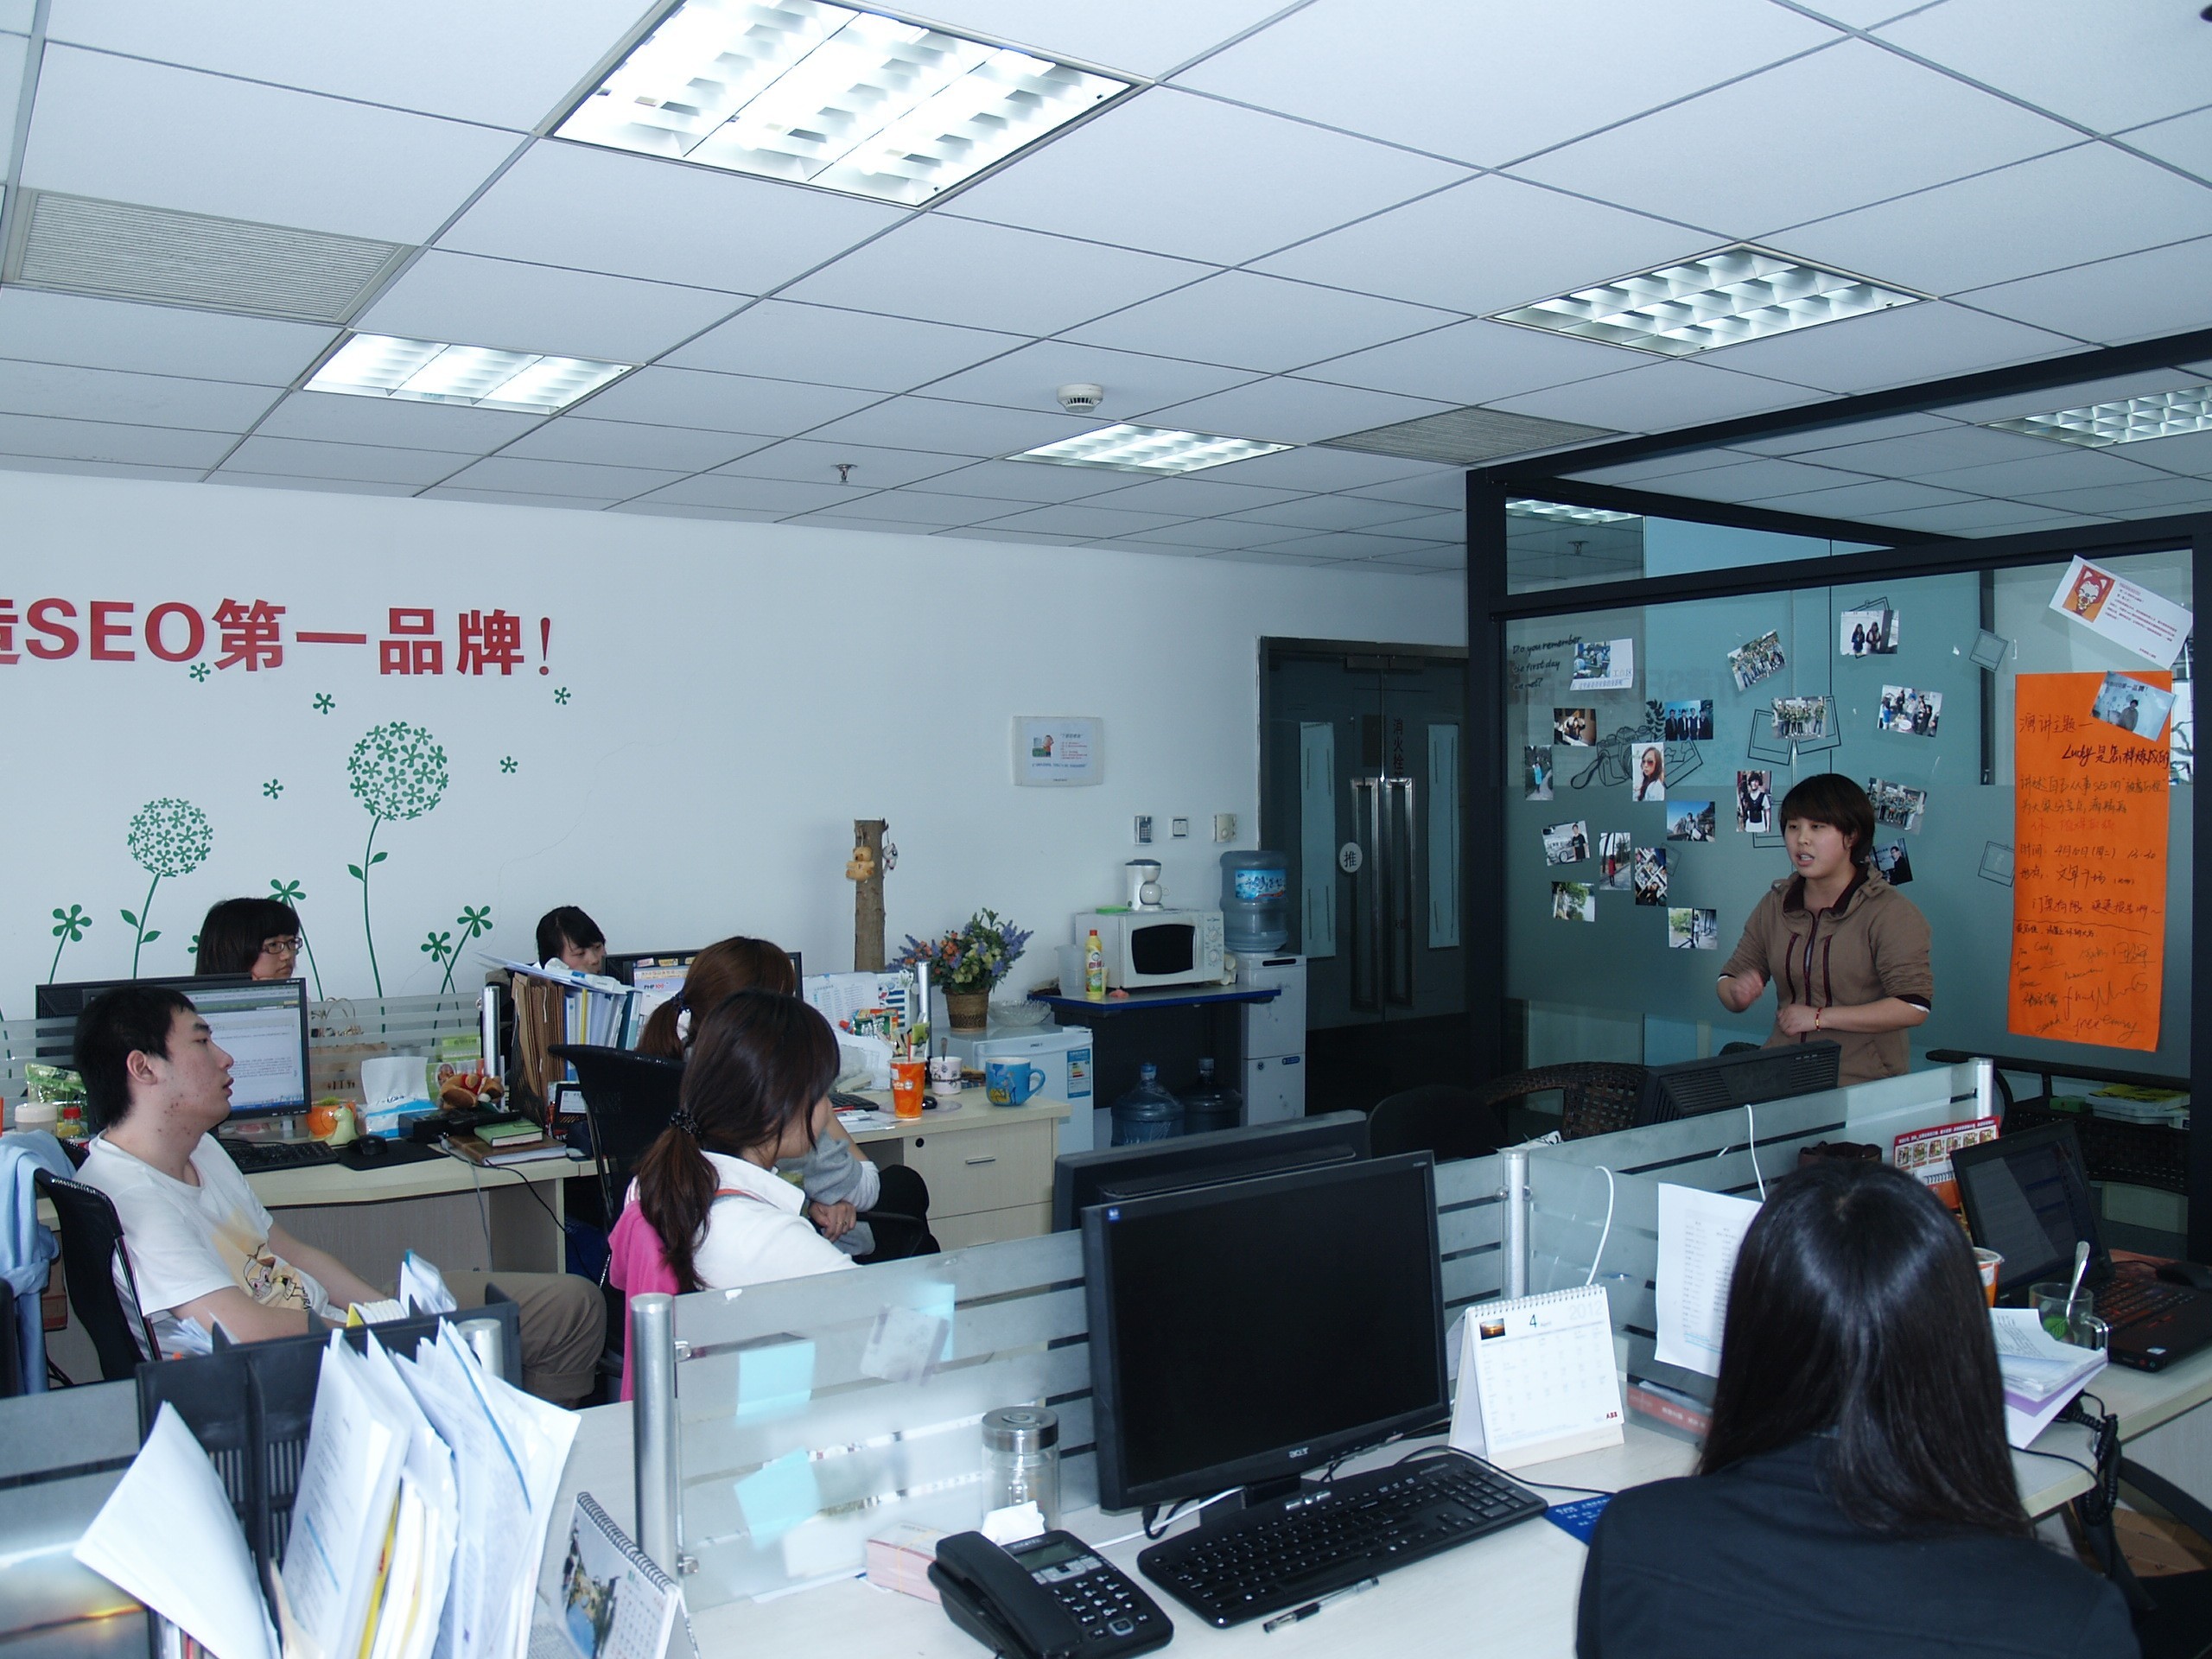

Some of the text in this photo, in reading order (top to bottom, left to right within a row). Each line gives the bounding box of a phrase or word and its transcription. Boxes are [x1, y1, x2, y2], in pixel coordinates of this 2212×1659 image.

[1513, 633, 1582, 657] Do you remember
[1545, 658, 1560, 671] day
[1344, 850, 1357, 868] 推
[1529, 1314, 1538, 1328] 4
[1569, 1300, 1604, 1321] 2012
[1288, 1446, 1309, 1459] acer
